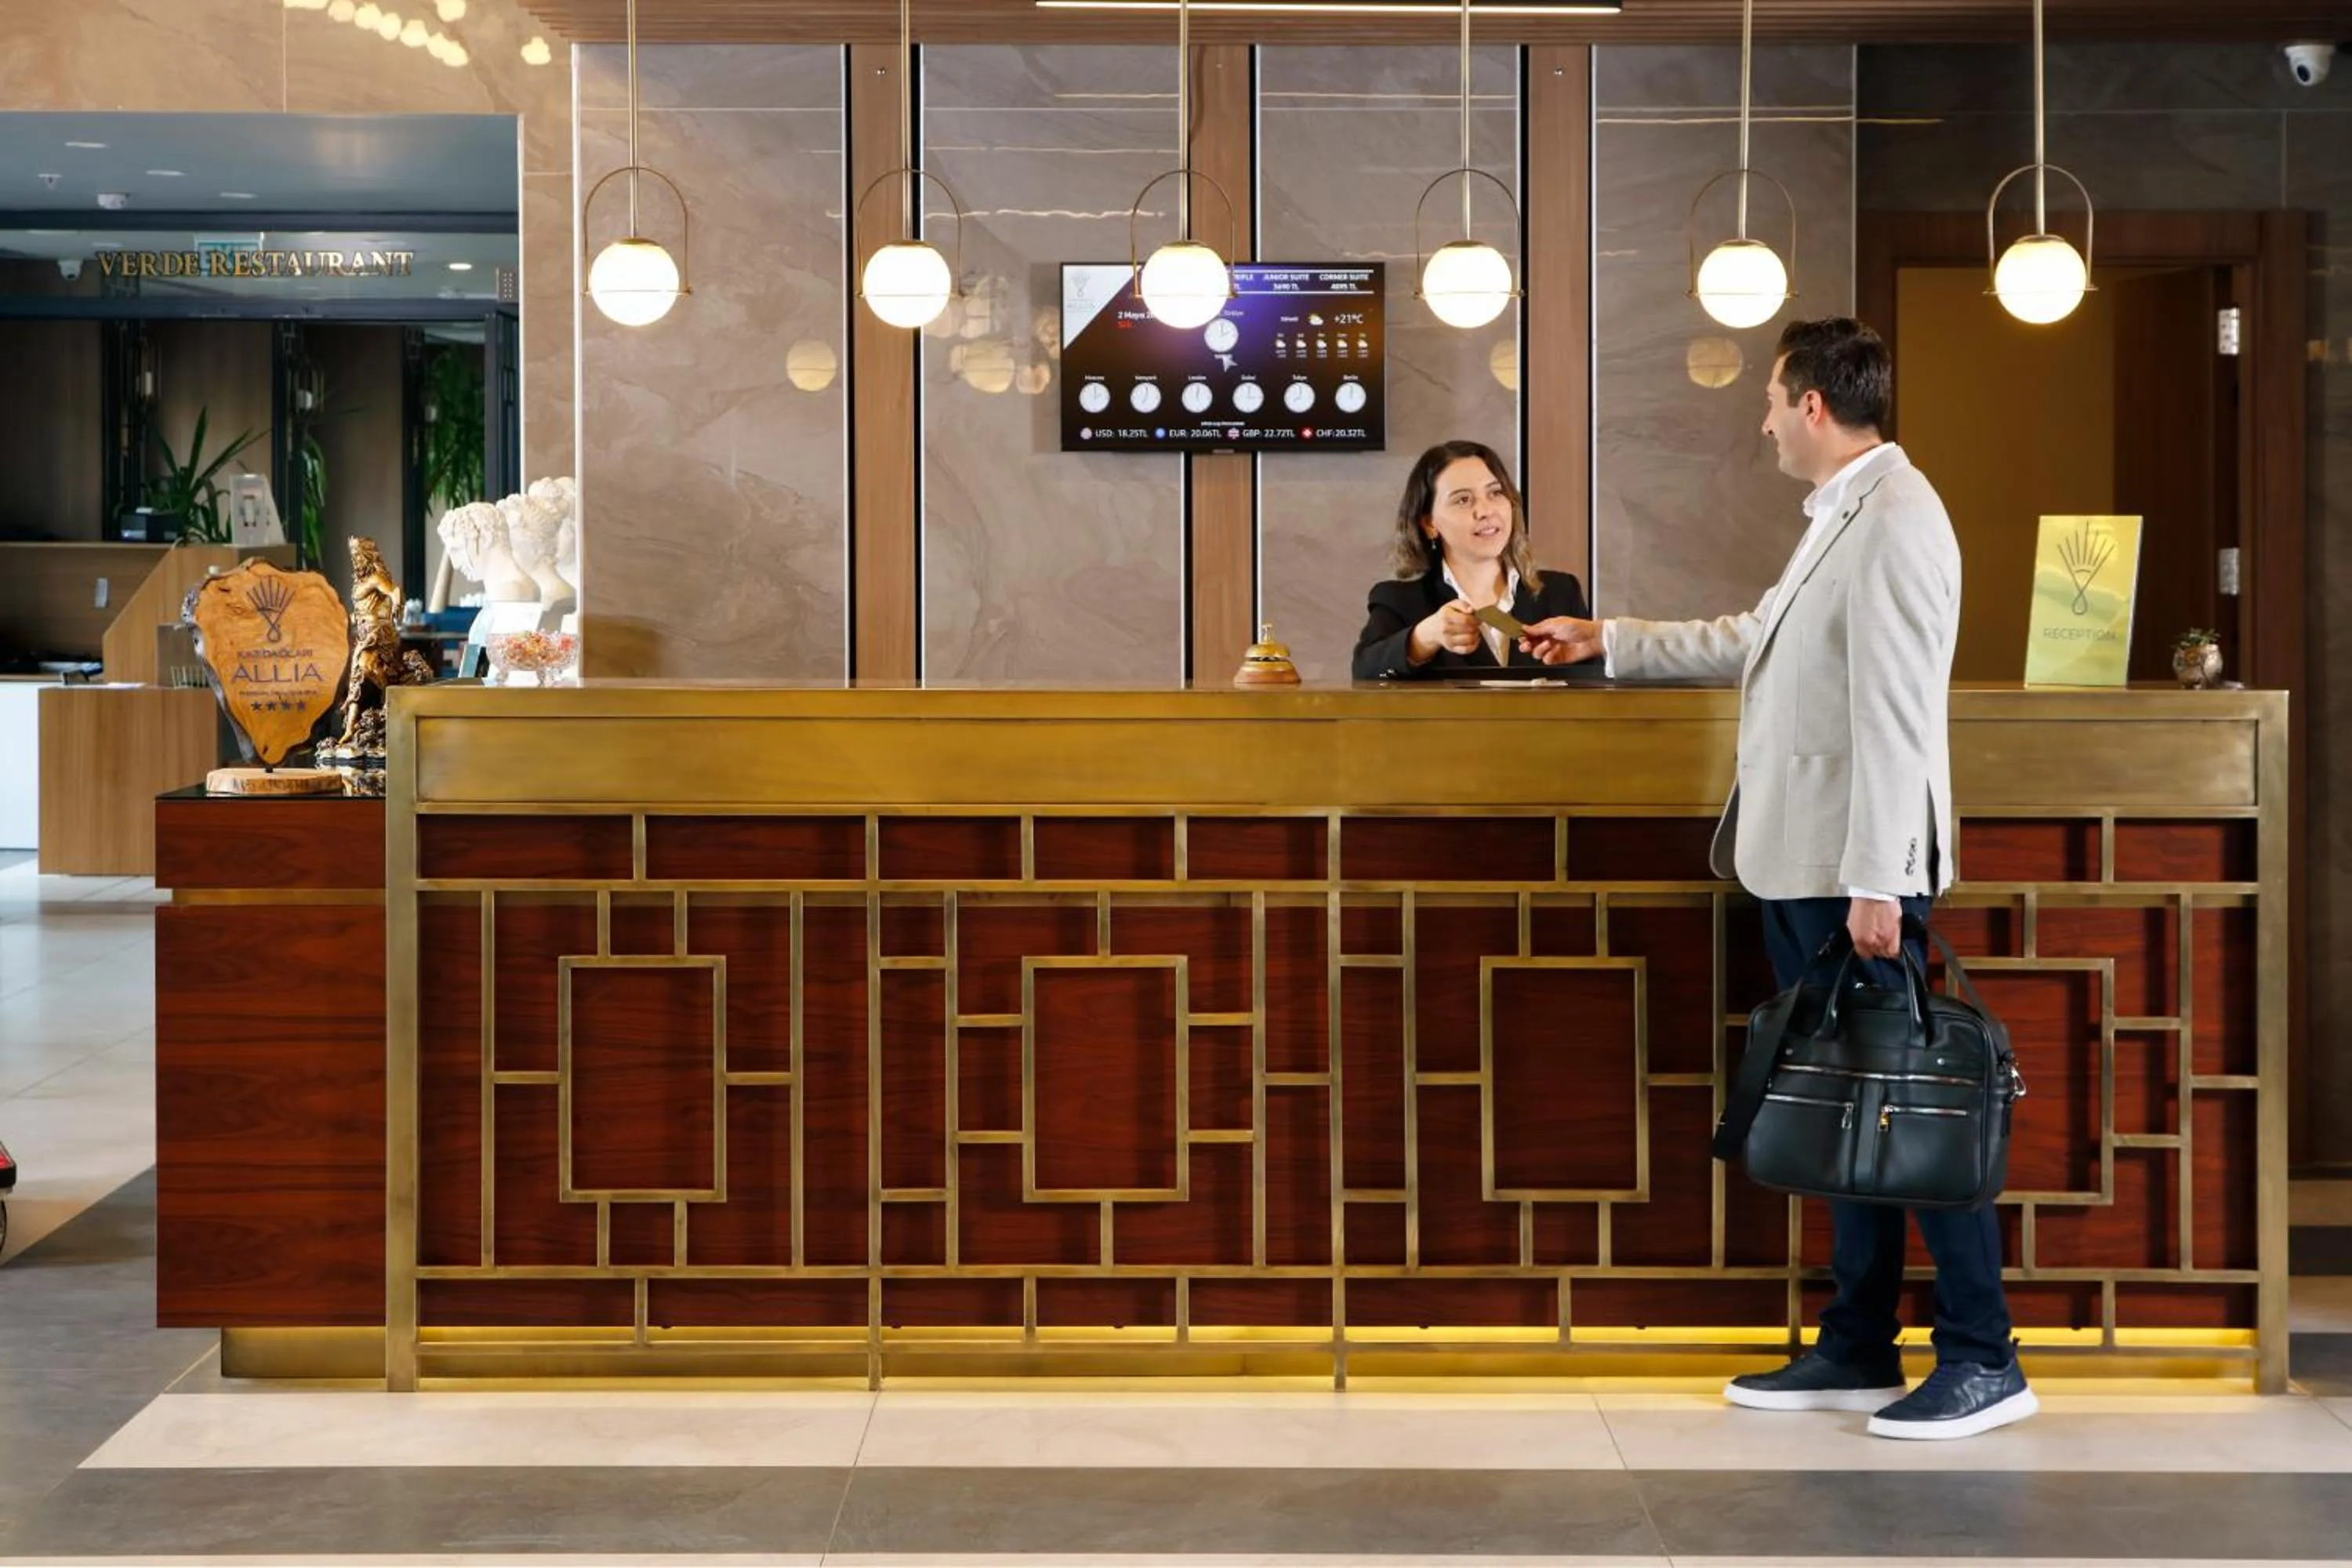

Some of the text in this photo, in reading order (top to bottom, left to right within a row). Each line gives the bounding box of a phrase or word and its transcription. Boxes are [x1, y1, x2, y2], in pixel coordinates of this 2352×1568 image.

[96, 250, 200, 278] VERDE
[209, 250, 414, 278] RESTAURANT
[1095, 429, 1115, 437] USD:
[1169, 429, 1187, 437] EUR:
[1243, 429, 1261, 437] GBP:
[2043, 627, 2117, 641] RECEPTION
[230, 662, 325, 683] ALLIA
